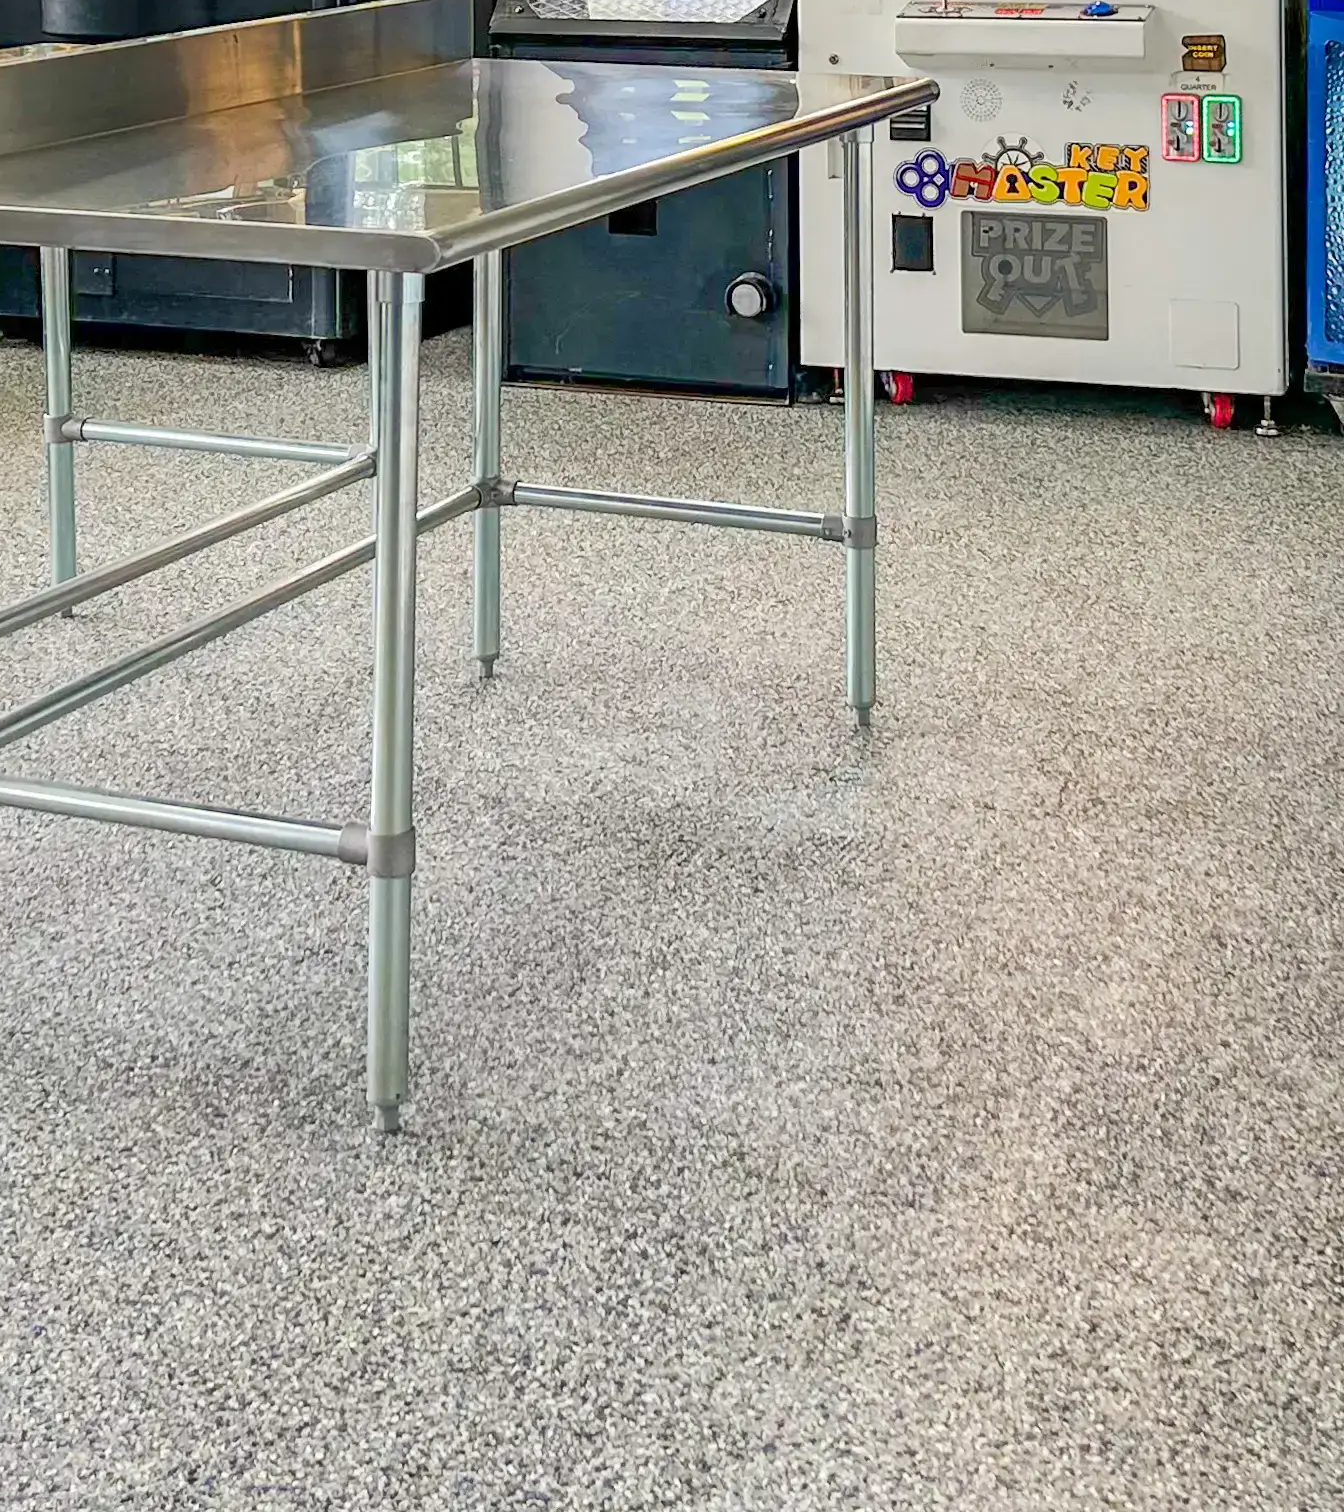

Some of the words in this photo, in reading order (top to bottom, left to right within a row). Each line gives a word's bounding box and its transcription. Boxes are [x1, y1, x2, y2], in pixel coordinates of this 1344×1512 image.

[1071, 146, 1148, 173] KEY
[952, 163, 1149, 209] MASTER
[979, 219, 1096, 252] PRIZE
[986, 252, 1090, 305] OUT
